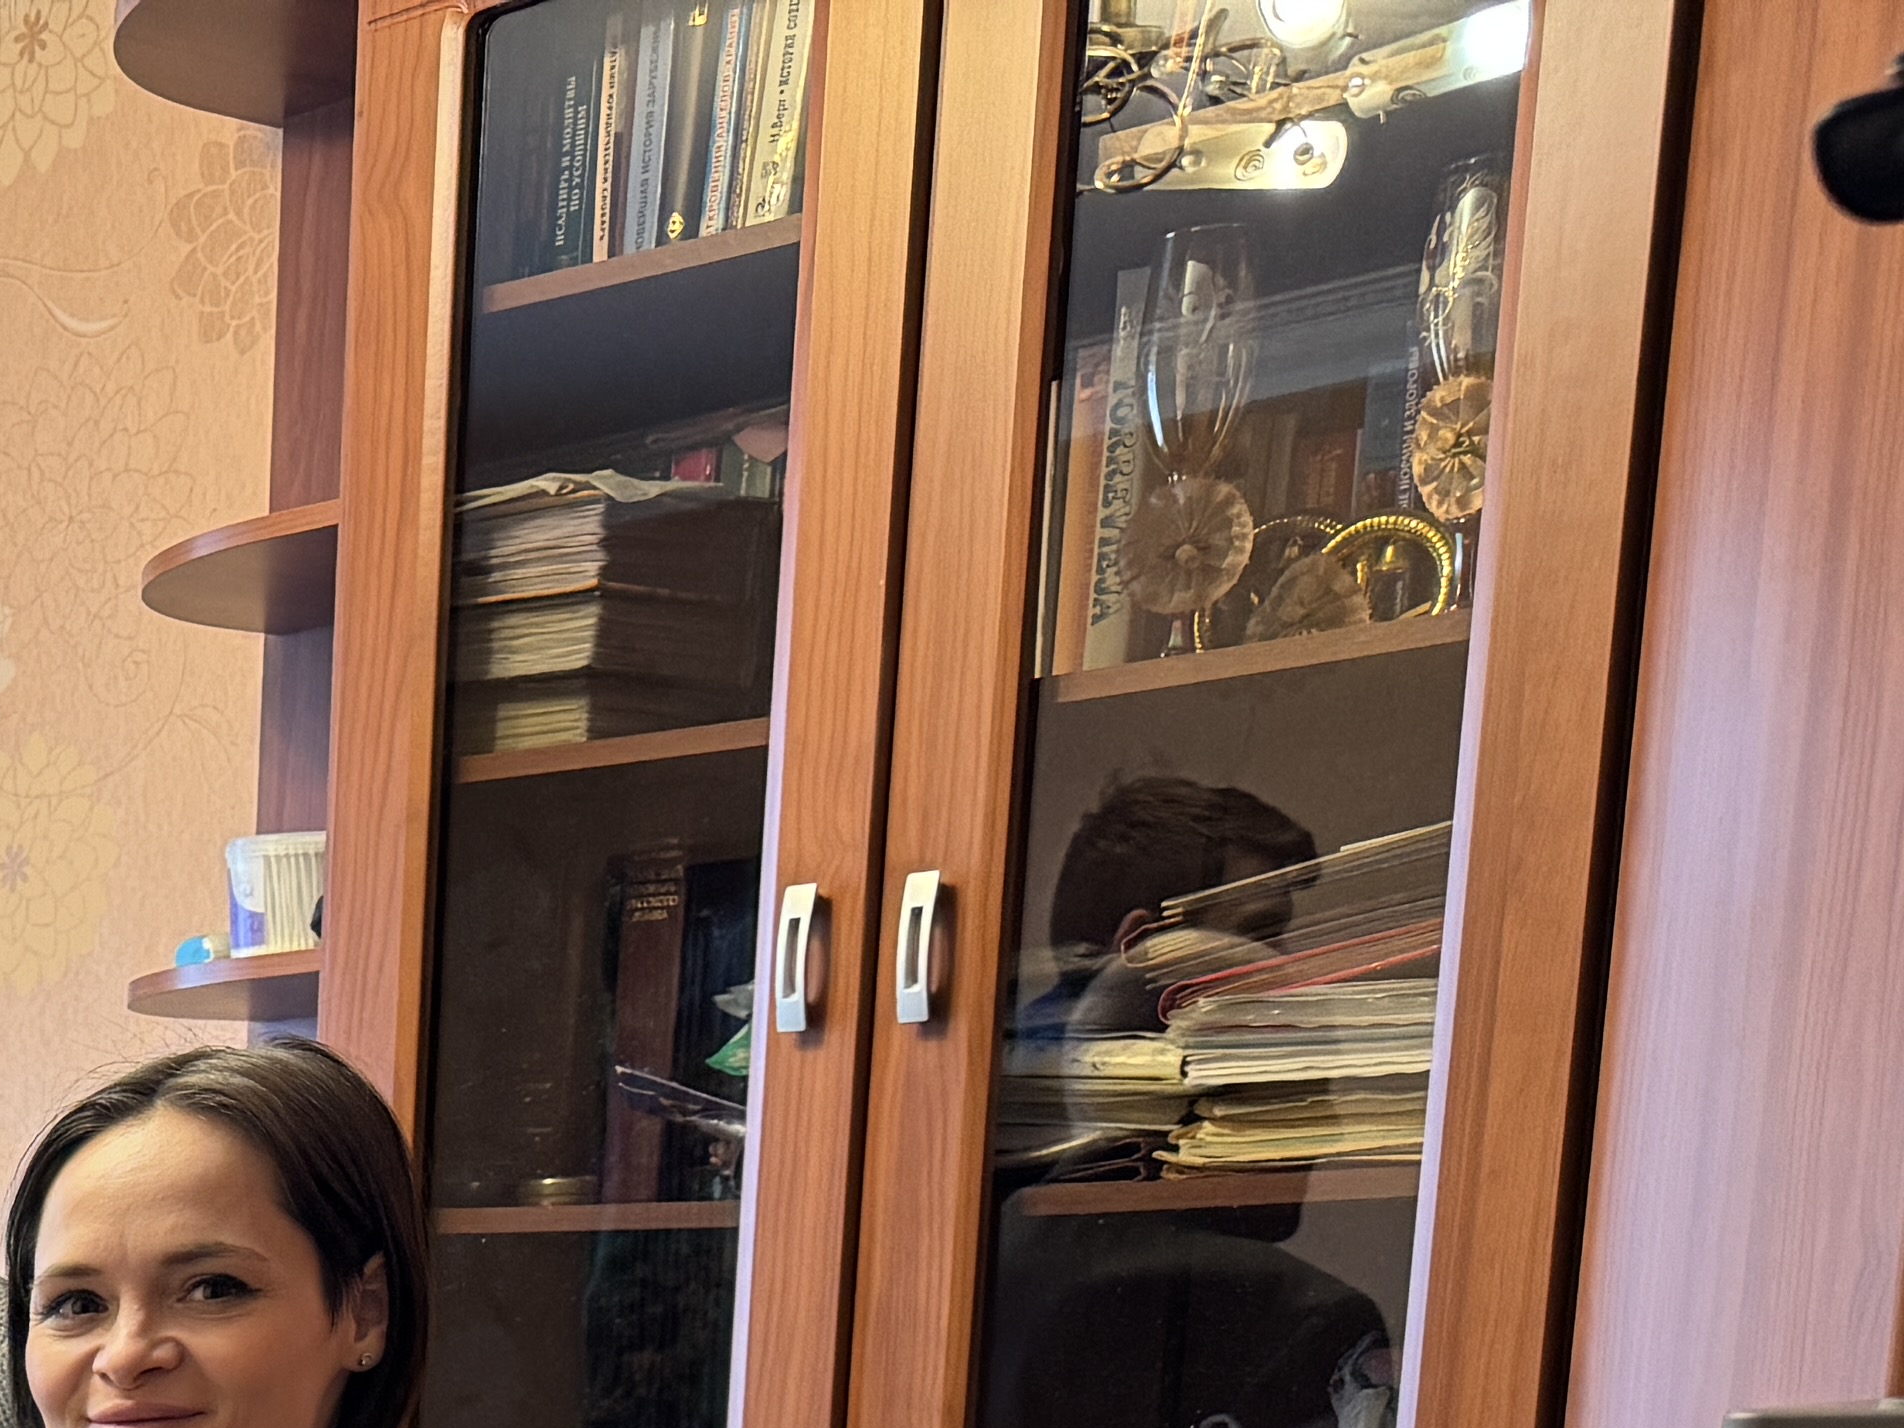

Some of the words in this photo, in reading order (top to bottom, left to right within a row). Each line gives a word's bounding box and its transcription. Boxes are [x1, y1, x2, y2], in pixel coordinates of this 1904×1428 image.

[778, 33, 797, 87] ИСТОРИЯ
[561, 76, 576, 152] МОЛИТВЫ
[641, 110, 655, 175] ИСТОРИЯ
[569, 188, 581, 212] ПО
